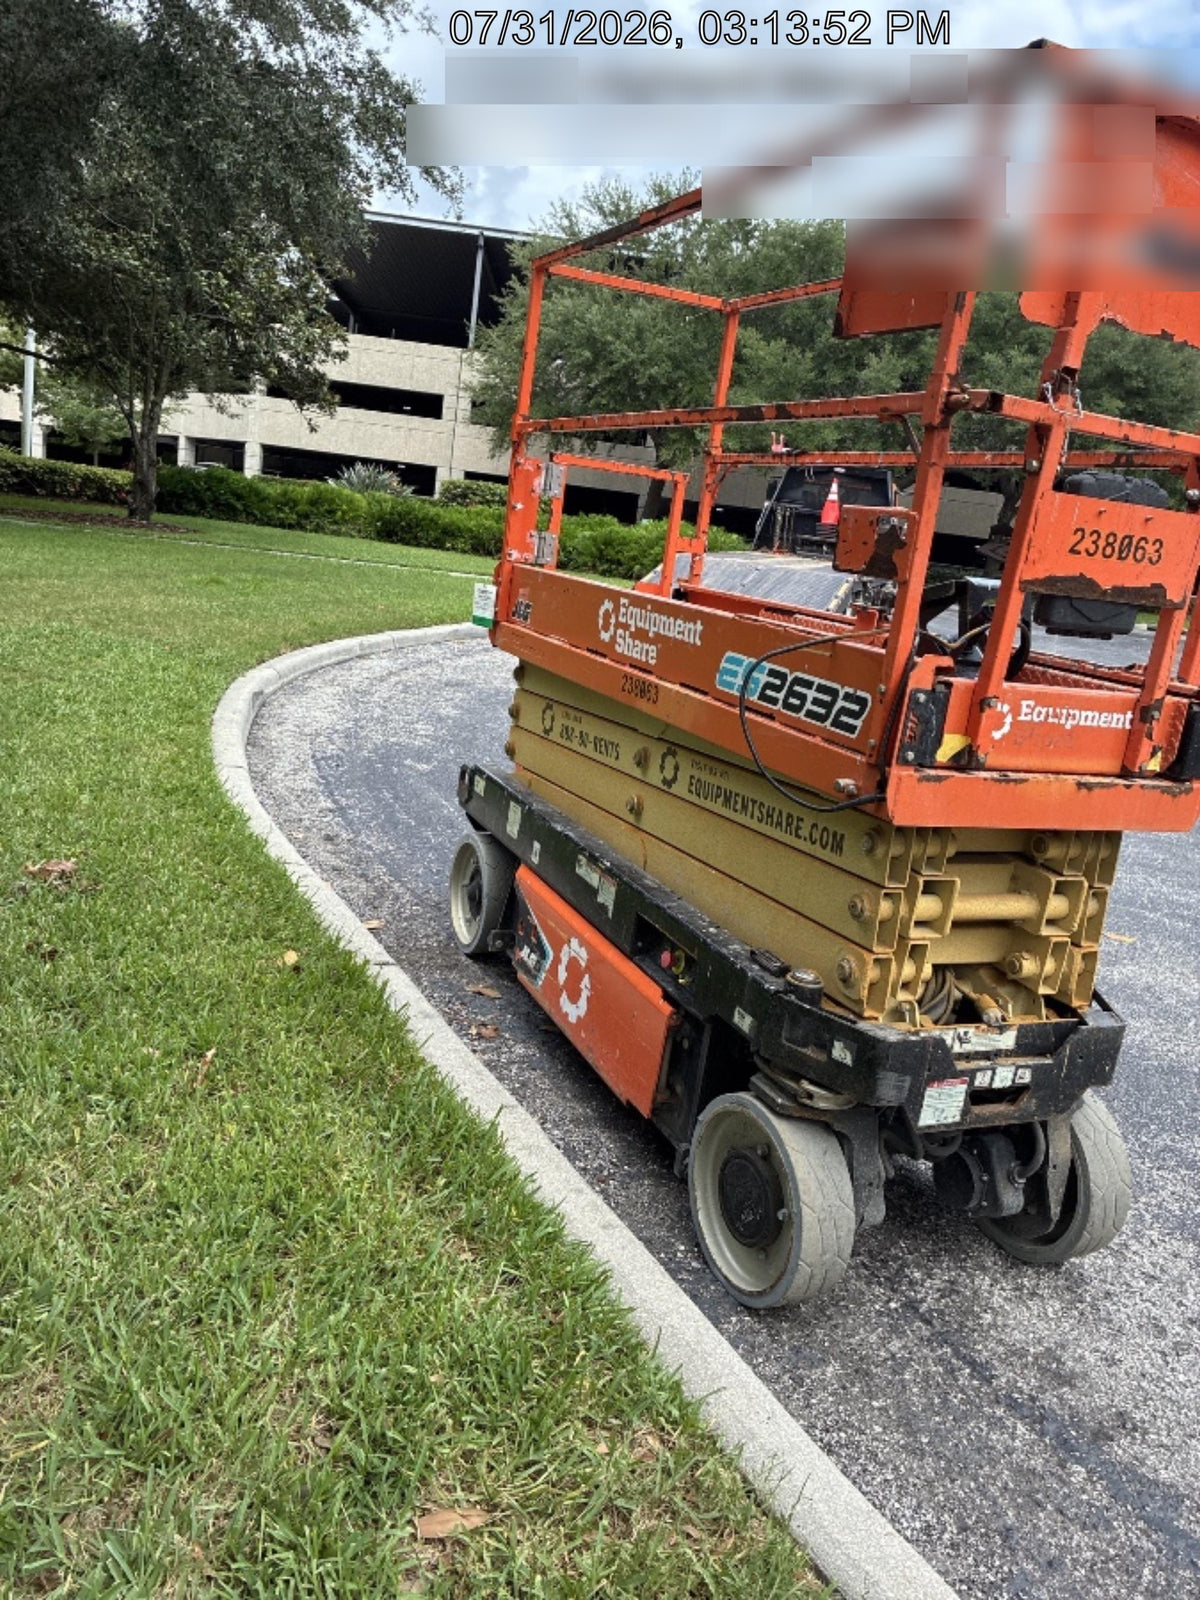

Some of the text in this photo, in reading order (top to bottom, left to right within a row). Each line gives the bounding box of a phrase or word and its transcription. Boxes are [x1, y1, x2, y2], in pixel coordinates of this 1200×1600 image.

[1068, 527, 1164, 566] 238063
[619, 597, 703, 646] Equipment
[615, 628, 657, 666] Share
[621, 674, 659, 704] 238063
[716, 651, 872, 739] ES2632
[688, 775, 845, 857] EQUIPMENTSHARE.COM
